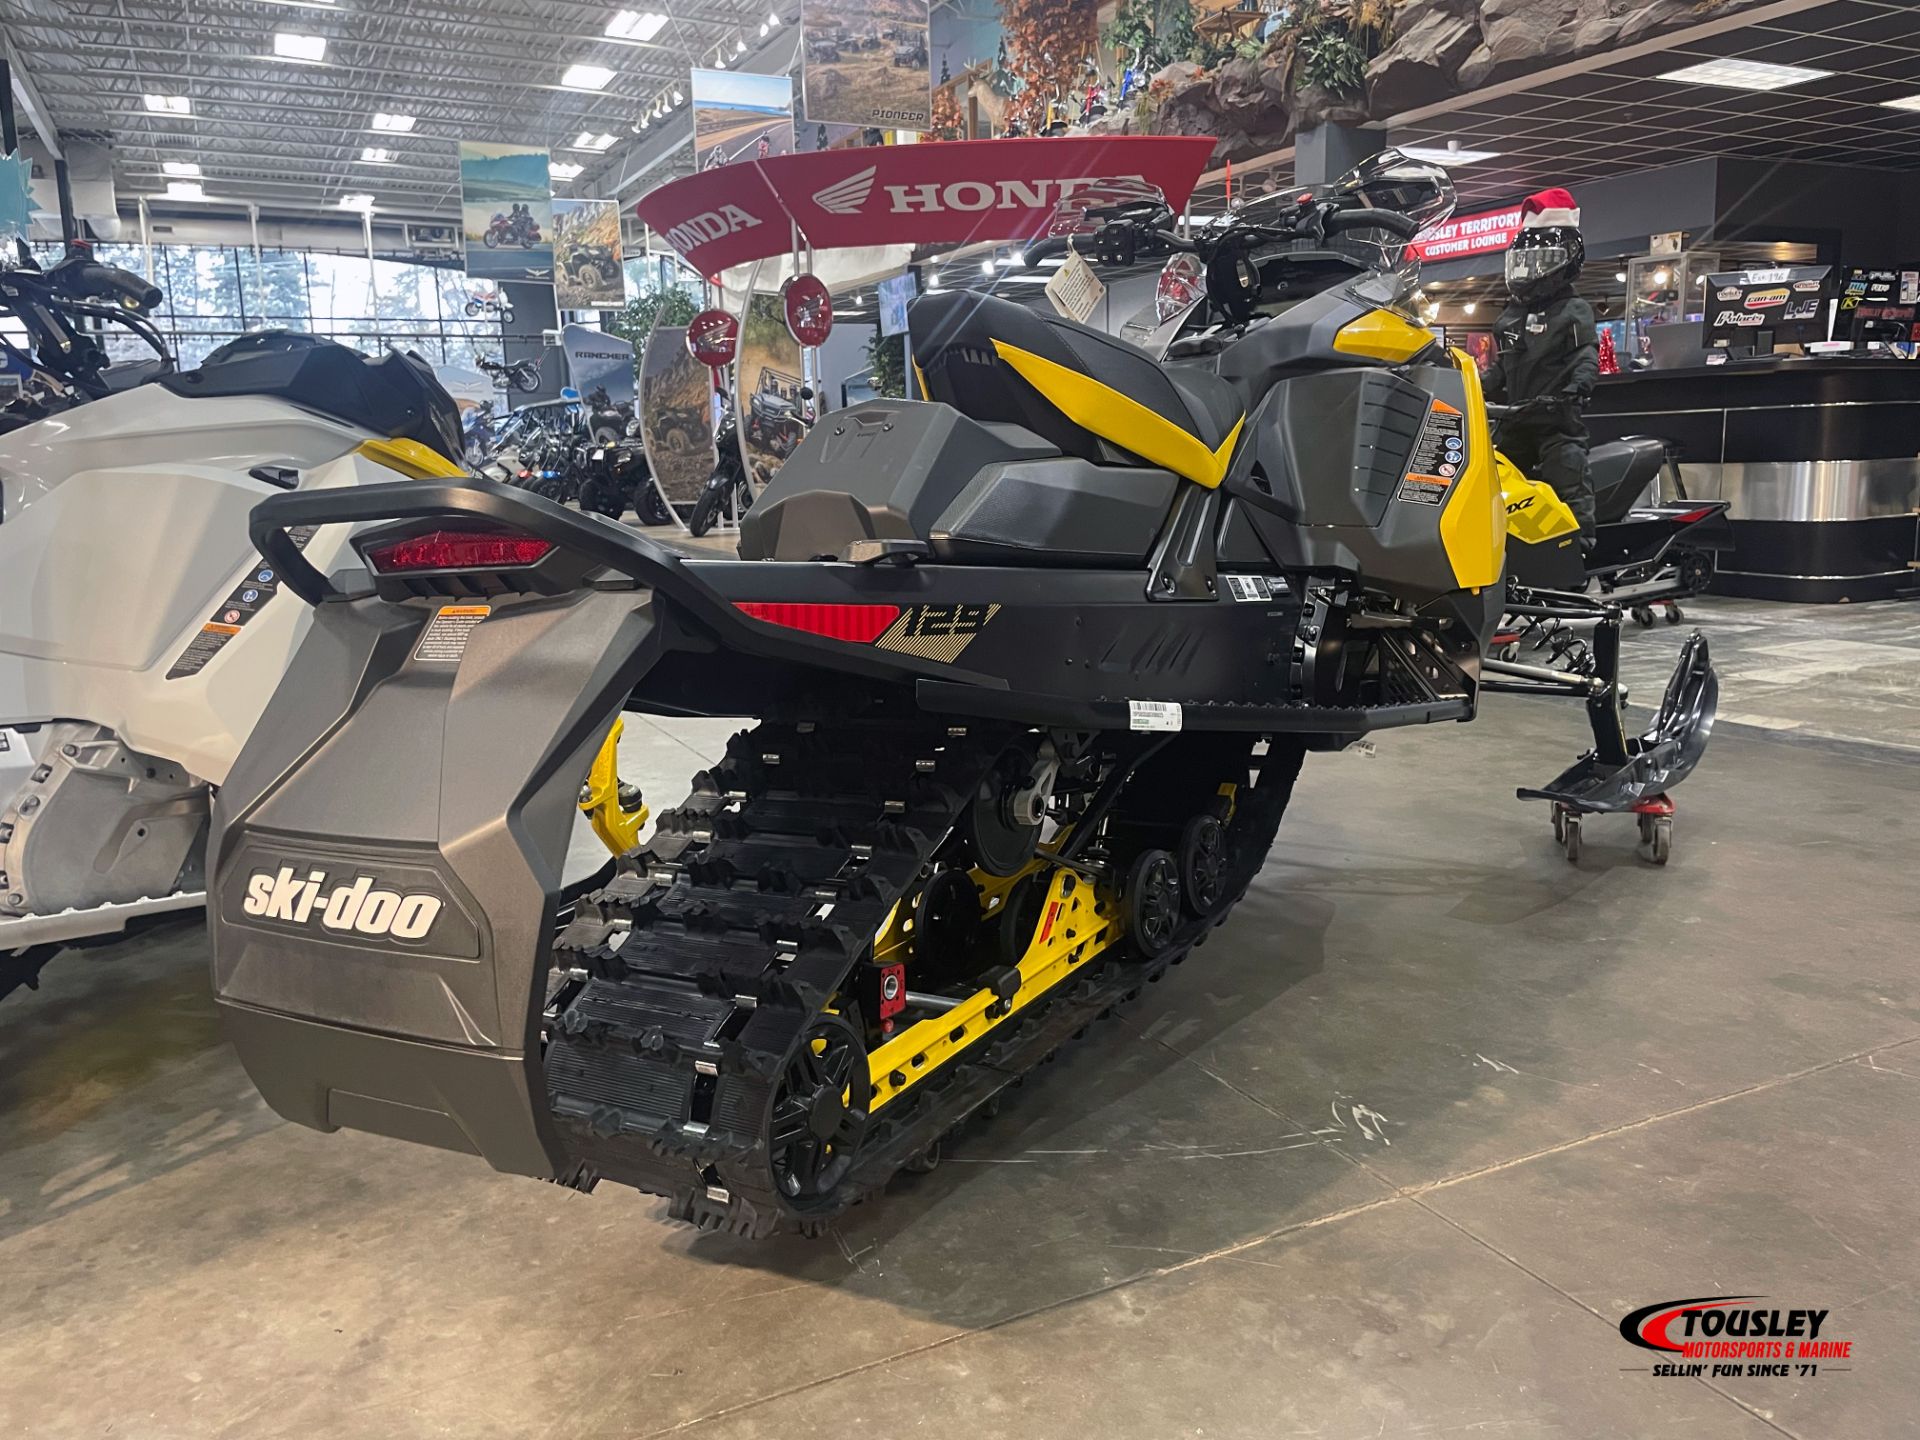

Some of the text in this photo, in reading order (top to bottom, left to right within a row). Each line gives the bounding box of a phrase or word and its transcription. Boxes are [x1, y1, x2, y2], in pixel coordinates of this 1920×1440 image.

[872, 109, 924, 121] PIONEER
[1460, 211, 1521, 236] TERRITORY
[1425, 232, 1507, 257] CUSTOMER LOUNGE
[1747, 294, 1786, 303] can-am
[1715, 311, 1763, 325] Polaris
[575, 351, 630, 361] RANCHER
[244, 866, 442, 939] ski-doo
